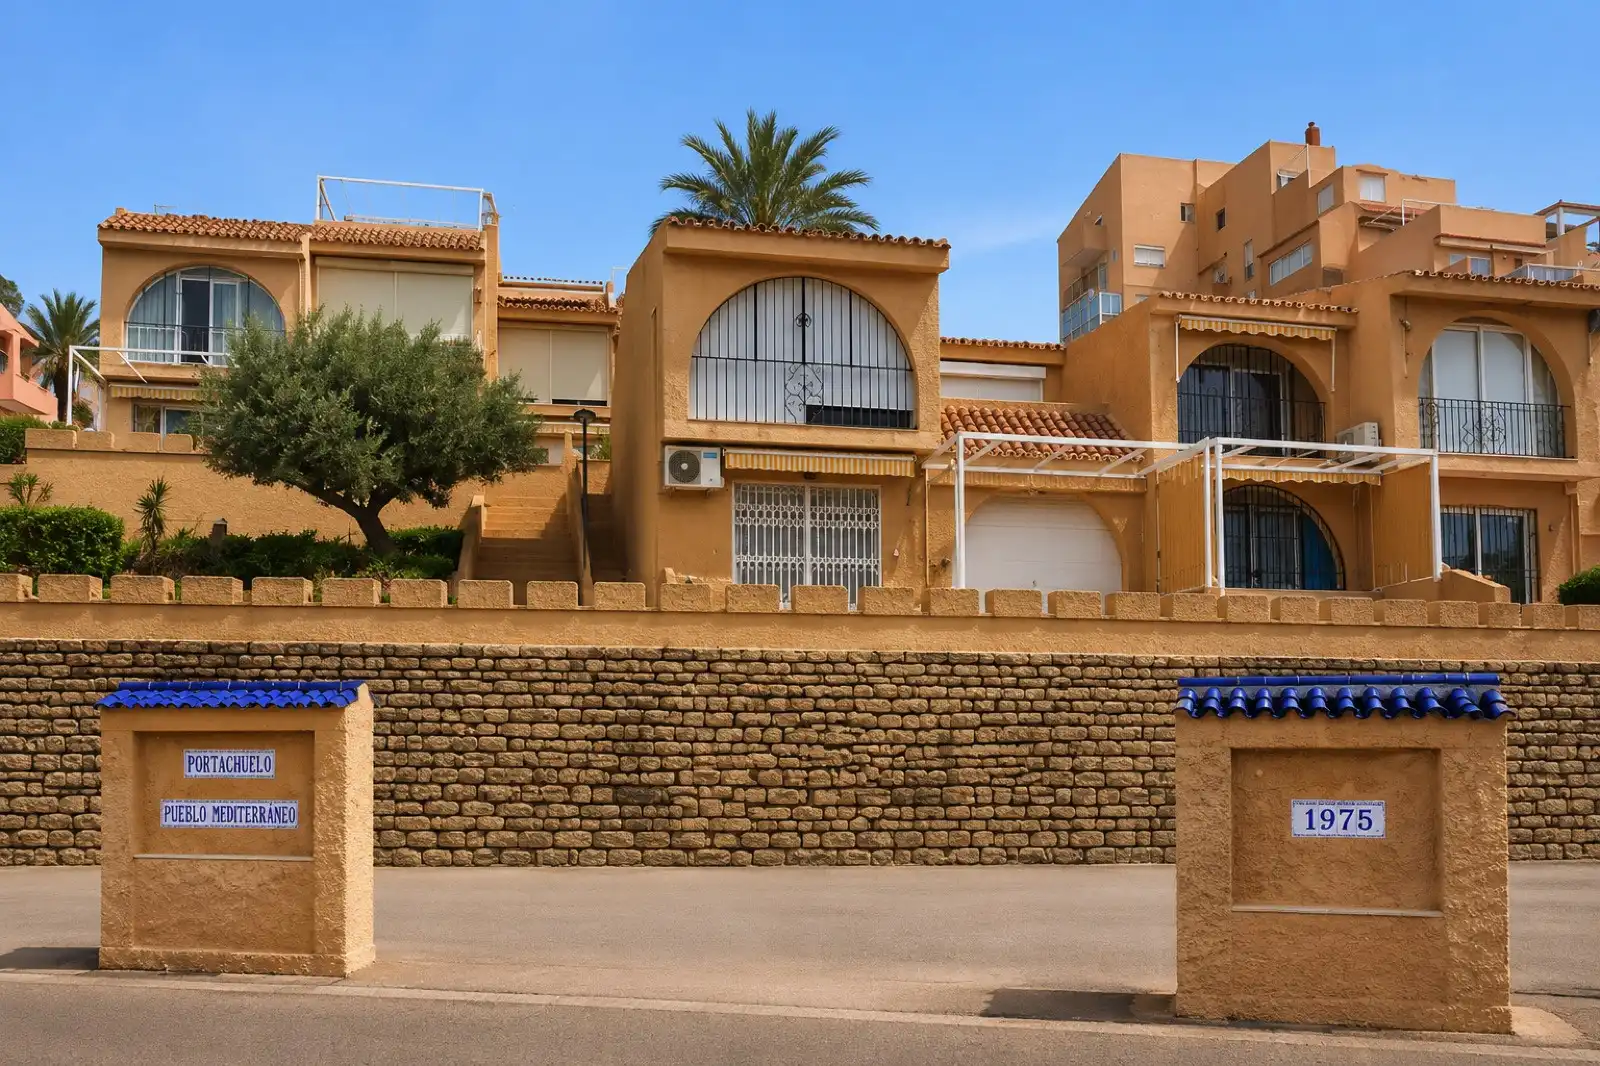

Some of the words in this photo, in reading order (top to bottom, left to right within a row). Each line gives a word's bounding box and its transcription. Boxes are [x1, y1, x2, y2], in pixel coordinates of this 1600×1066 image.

[187, 755, 272, 773] PORTACHUELO
[164, 805, 207, 823] PUEBLO
[212, 802, 296, 824] MEDITERRÁNEO
[1305, 808, 1373, 831] 1975
